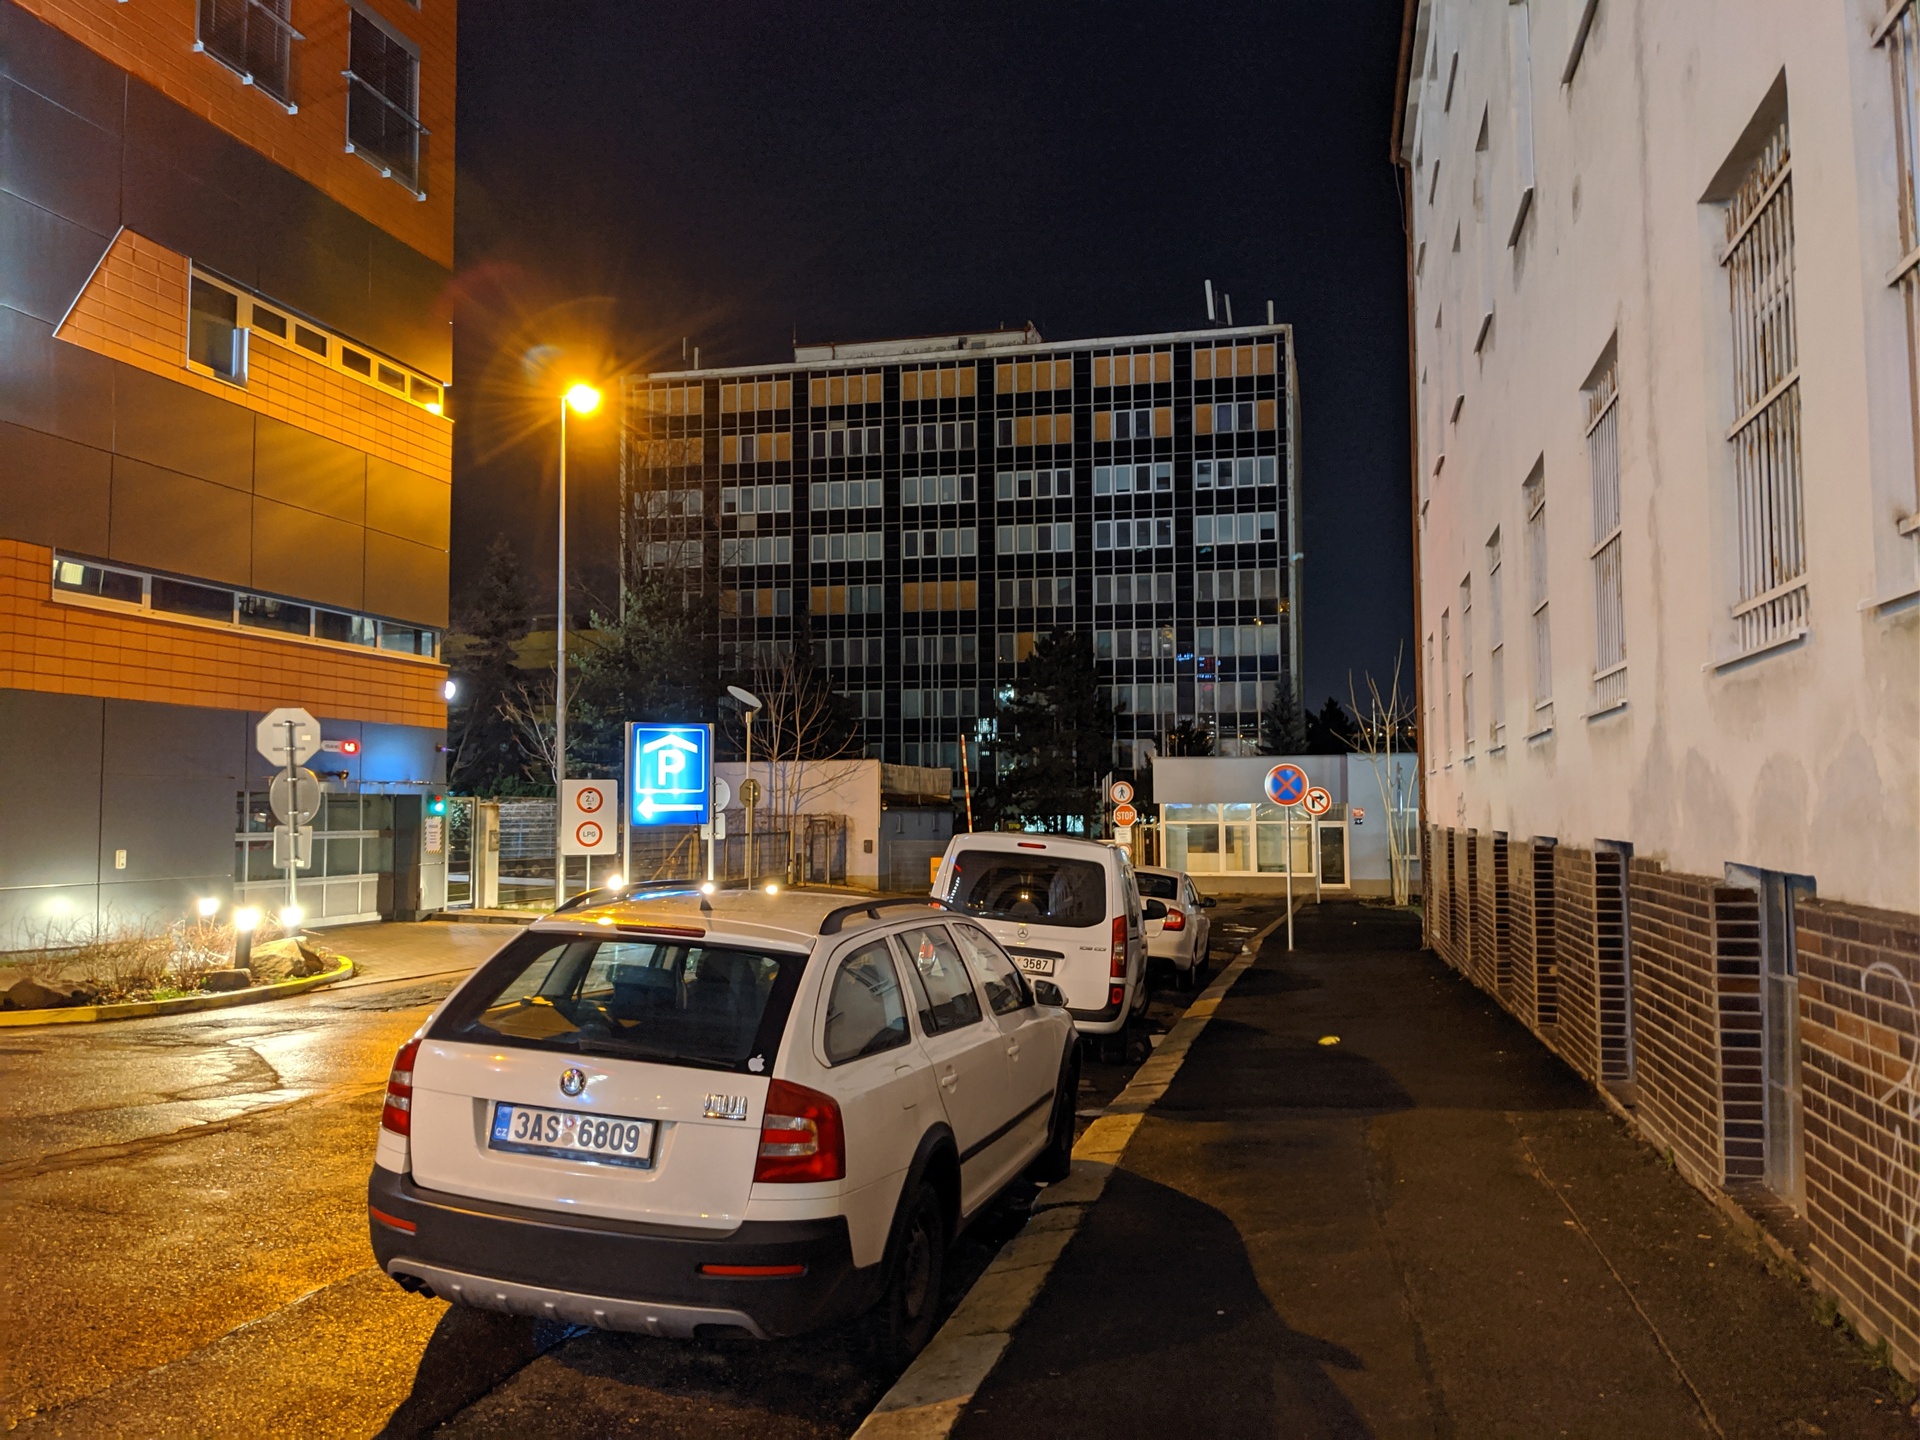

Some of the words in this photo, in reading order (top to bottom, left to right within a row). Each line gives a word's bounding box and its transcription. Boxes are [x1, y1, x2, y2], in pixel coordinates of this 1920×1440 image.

[658, 748, 686, 786] P
[1116, 811, 1134, 820] STOP
[1023, 958, 1048, 970] 3587
[495, 1127, 508, 1137] CZ
[514, 1111, 561, 1143] 3AS
[577, 1119, 640, 1153] 6809
